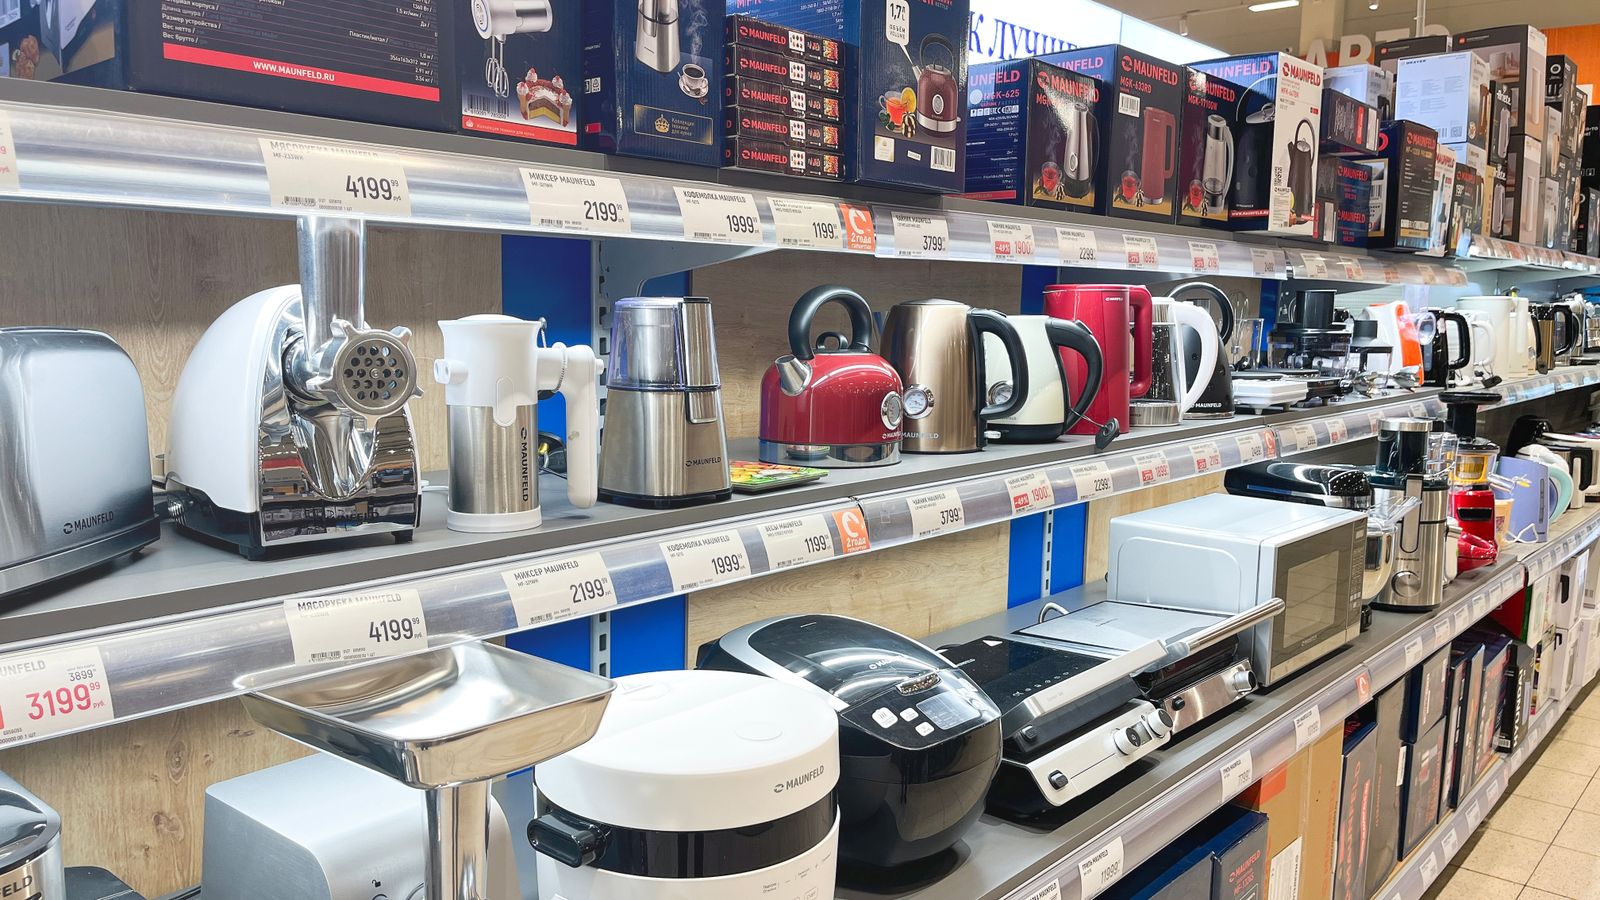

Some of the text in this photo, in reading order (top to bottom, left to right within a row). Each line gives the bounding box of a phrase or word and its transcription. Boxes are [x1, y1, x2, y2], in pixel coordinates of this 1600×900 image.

[890, 3, 902, 20] 1,7
[162, 13, 218, 29] Размер устройства
[749, 28, 786, 45] MAUNFELD
[253, 61, 335, 82] WWW.MAUNFELD.RU
[749, 60, 787, 76] MAUNFELD
[1058, 56, 1104, 70] UNFELD
[970, 70, 1021, 86] UNFELD
[1133, 58, 1178, 86] MAUNFELD
[1290, 64, 1321, 87] MAUNFELD
[1051, 74, 1100, 103] MAUNFELD
[1205, 80, 1236, 103] AUNFELD
[750, 90, 788, 106] MAUNFELD
[751, 119, 788, 134] MAUNFELD
[750, 150, 788, 165] MAUNFELD
[529, 172, 596, 187] МИКСЕР MAUNFELD
[1343, 167, 1368, 182] MAUNFELD
[346, 175, 392, 201] 4199
[719, 194, 746, 203] MAUNFELD
[583, 200, 618, 222] 2199
[1341, 209, 1366, 224] MAUNFELD
[726, 214, 754, 234] 1999
[812, 222, 834, 239] 1199
[851, 233, 857, 243] 2
[923, 235, 943, 251] 3799
[1015, 241, 1031, 254] 1900
[902, 431, 939, 439] MAUNLD
[693, 457, 721, 466] MAUNFELD
[521, 442, 529, 502] MAUNFELD
[1032, 487, 1047, 501] 1900
[74, 510, 114, 531] MAUNFELD
[780, 520, 803, 529] MAUNFELD
[940, 508, 958, 525] 3799
[667, 535, 730, 552] КОФЕМОЛКА MAUNFELD
[805, 535, 827, 553] 1199
[847, 538, 852, 548] 2
[514, 560, 579, 581] МИКСЕР MAUNFELD
[712, 554, 740, 575] 1999
[570, 579, 605, 603] 2199
[369, 618, 413, 642] 4199
[0, 660, 46, 677] UNFELD
[69, 669, 94, 682] 3899
[26, 684, 91, 720] 3199
[89, 681, 101, 691] 99
[1513, 668, 1524, 748] HYUNDAI
[786, 765, 825, 790] MAUNFELD
[0, 875, 33, 898] ELD
